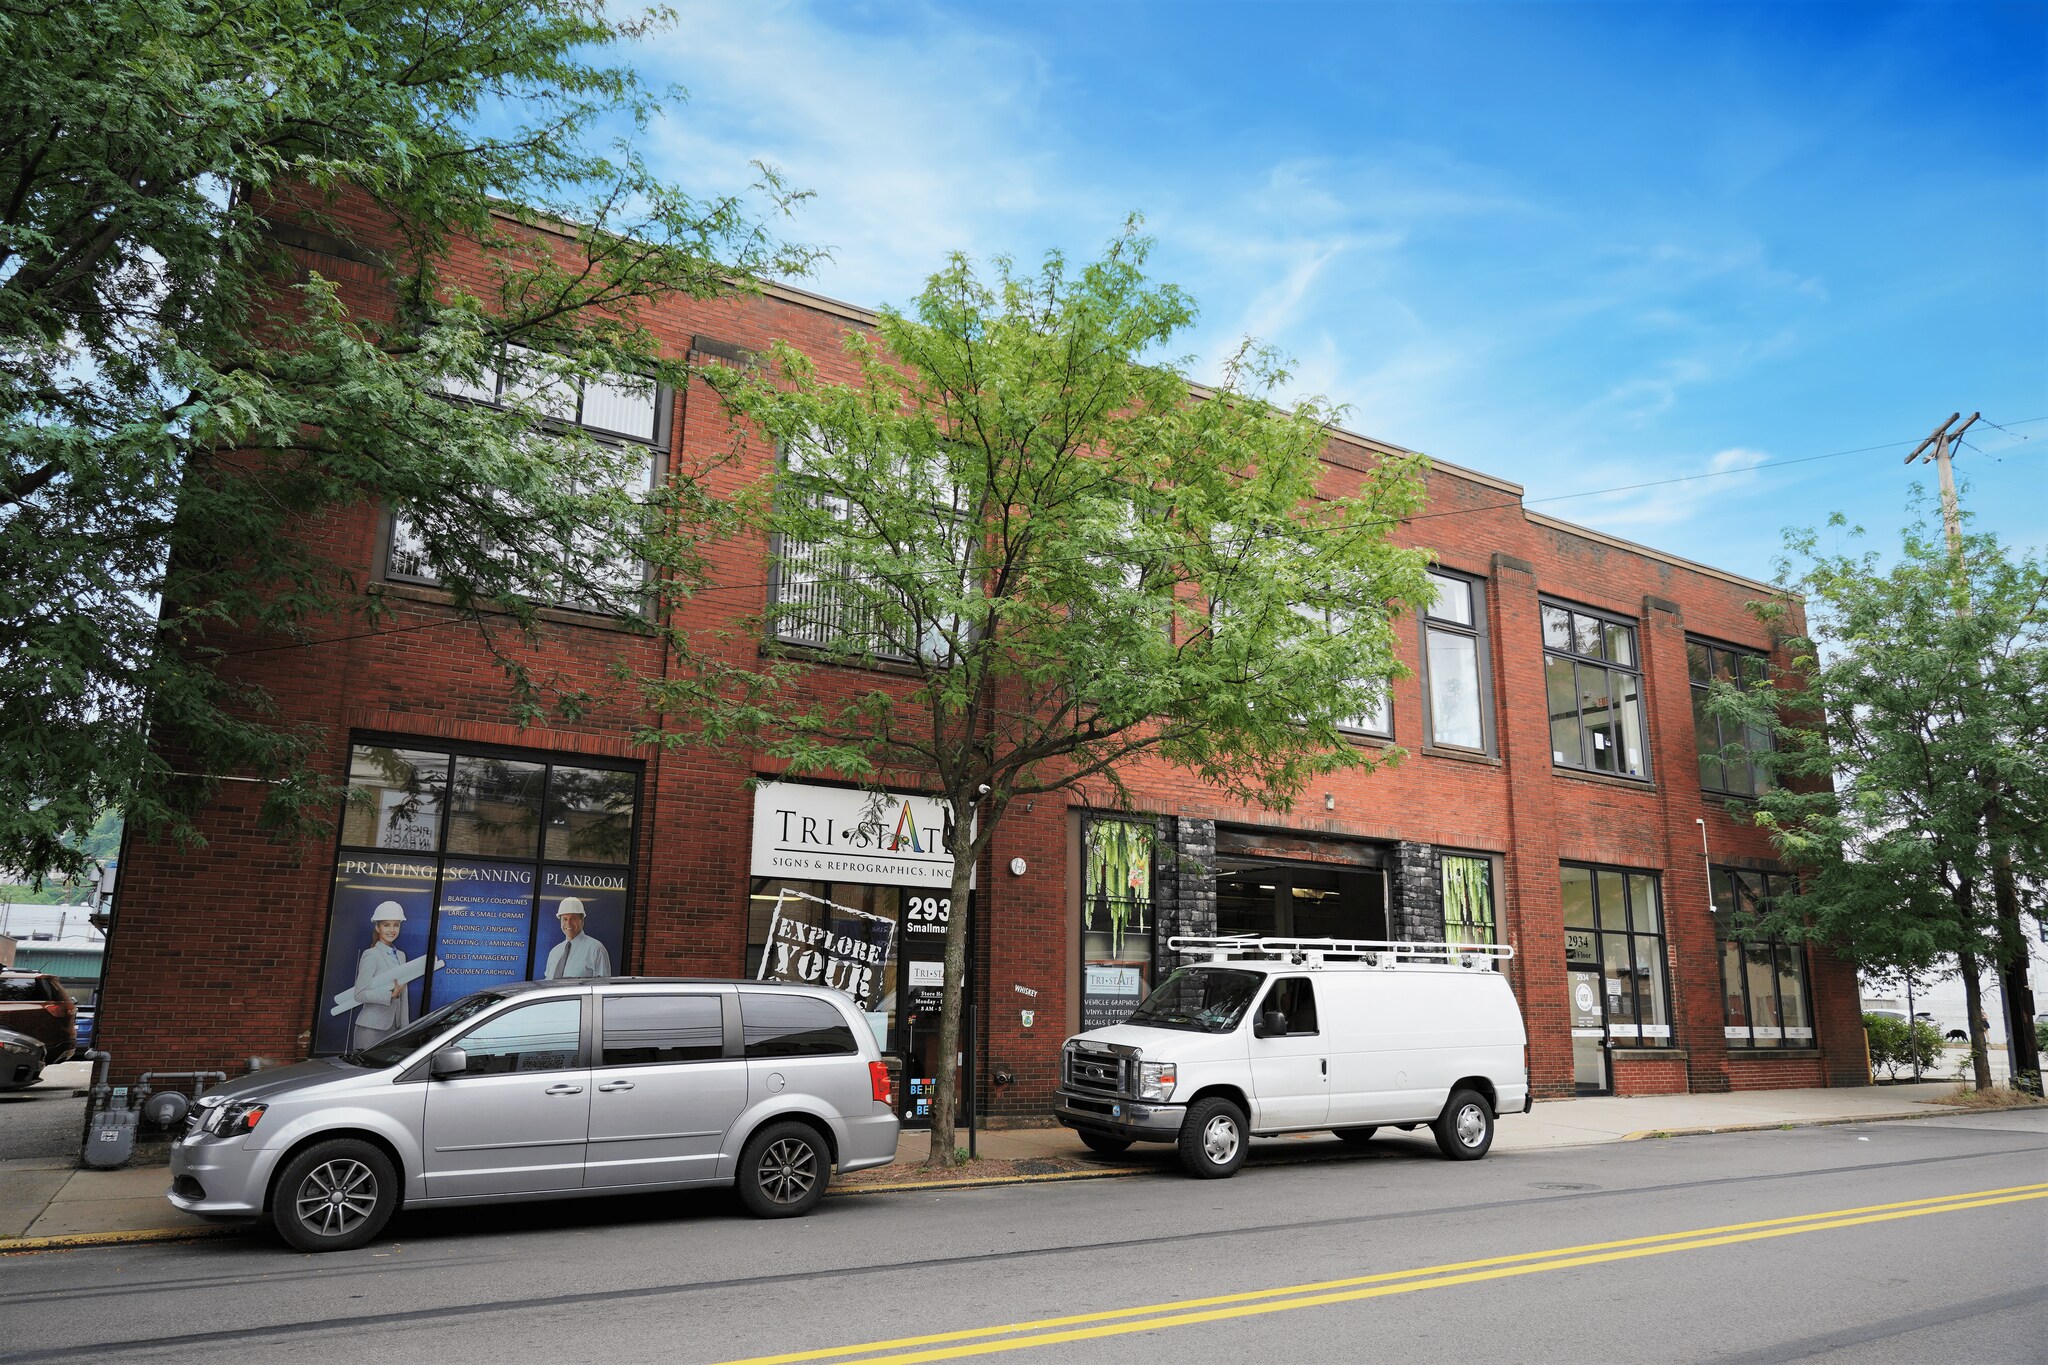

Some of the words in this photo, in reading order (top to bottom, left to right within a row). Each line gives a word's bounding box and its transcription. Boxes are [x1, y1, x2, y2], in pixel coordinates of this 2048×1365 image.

[345, 860, 434, 878] PRINTING
[772, 857, 809, 868] SIGNS
[814, 860, 822, 869] &
[449, 867, 531, 884] SCANNING
[546, 873, 624, 889] PLANROOM
[490, 897, 528, 906] COLORLINES
[907, 896, 951, 922] 293
[486, 925, 518, 933] FINISHING
[485, 939, 525, 948] LAMINATING
[777, 917, 882, 965] EXPLORE
[1568, 935, 1589, 948] 2934
[446, 967, 483, 975] DOCUMENT
[485, 968, 516, 976] ARCHIVAL
[775, 941, 873, 998] YOUR
[1576, 973, 1589, 981] 2934
[911, 1085, 923, 1094] BE
[917, 1106, 929, 1115] BE
